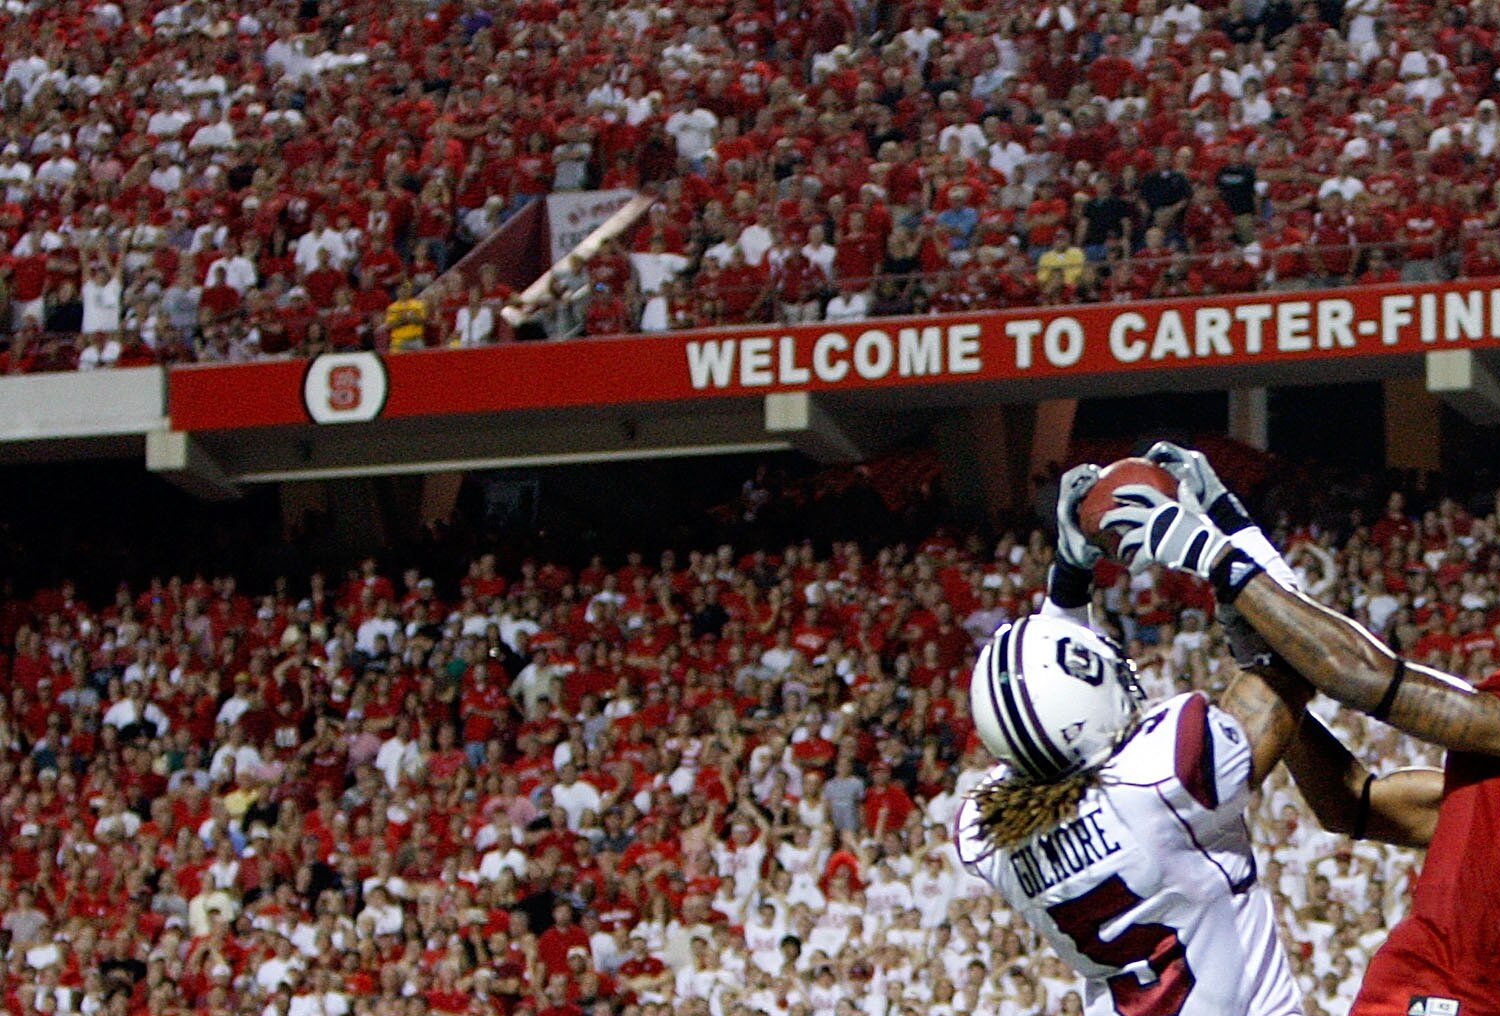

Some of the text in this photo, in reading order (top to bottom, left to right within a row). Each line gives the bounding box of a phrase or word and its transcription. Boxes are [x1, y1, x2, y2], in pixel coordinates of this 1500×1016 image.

[686, 324, 982, 390] WELCOME
[1005, 316, 1086, 370] TO
[1009, 807, 1122, 898] GILMORE
